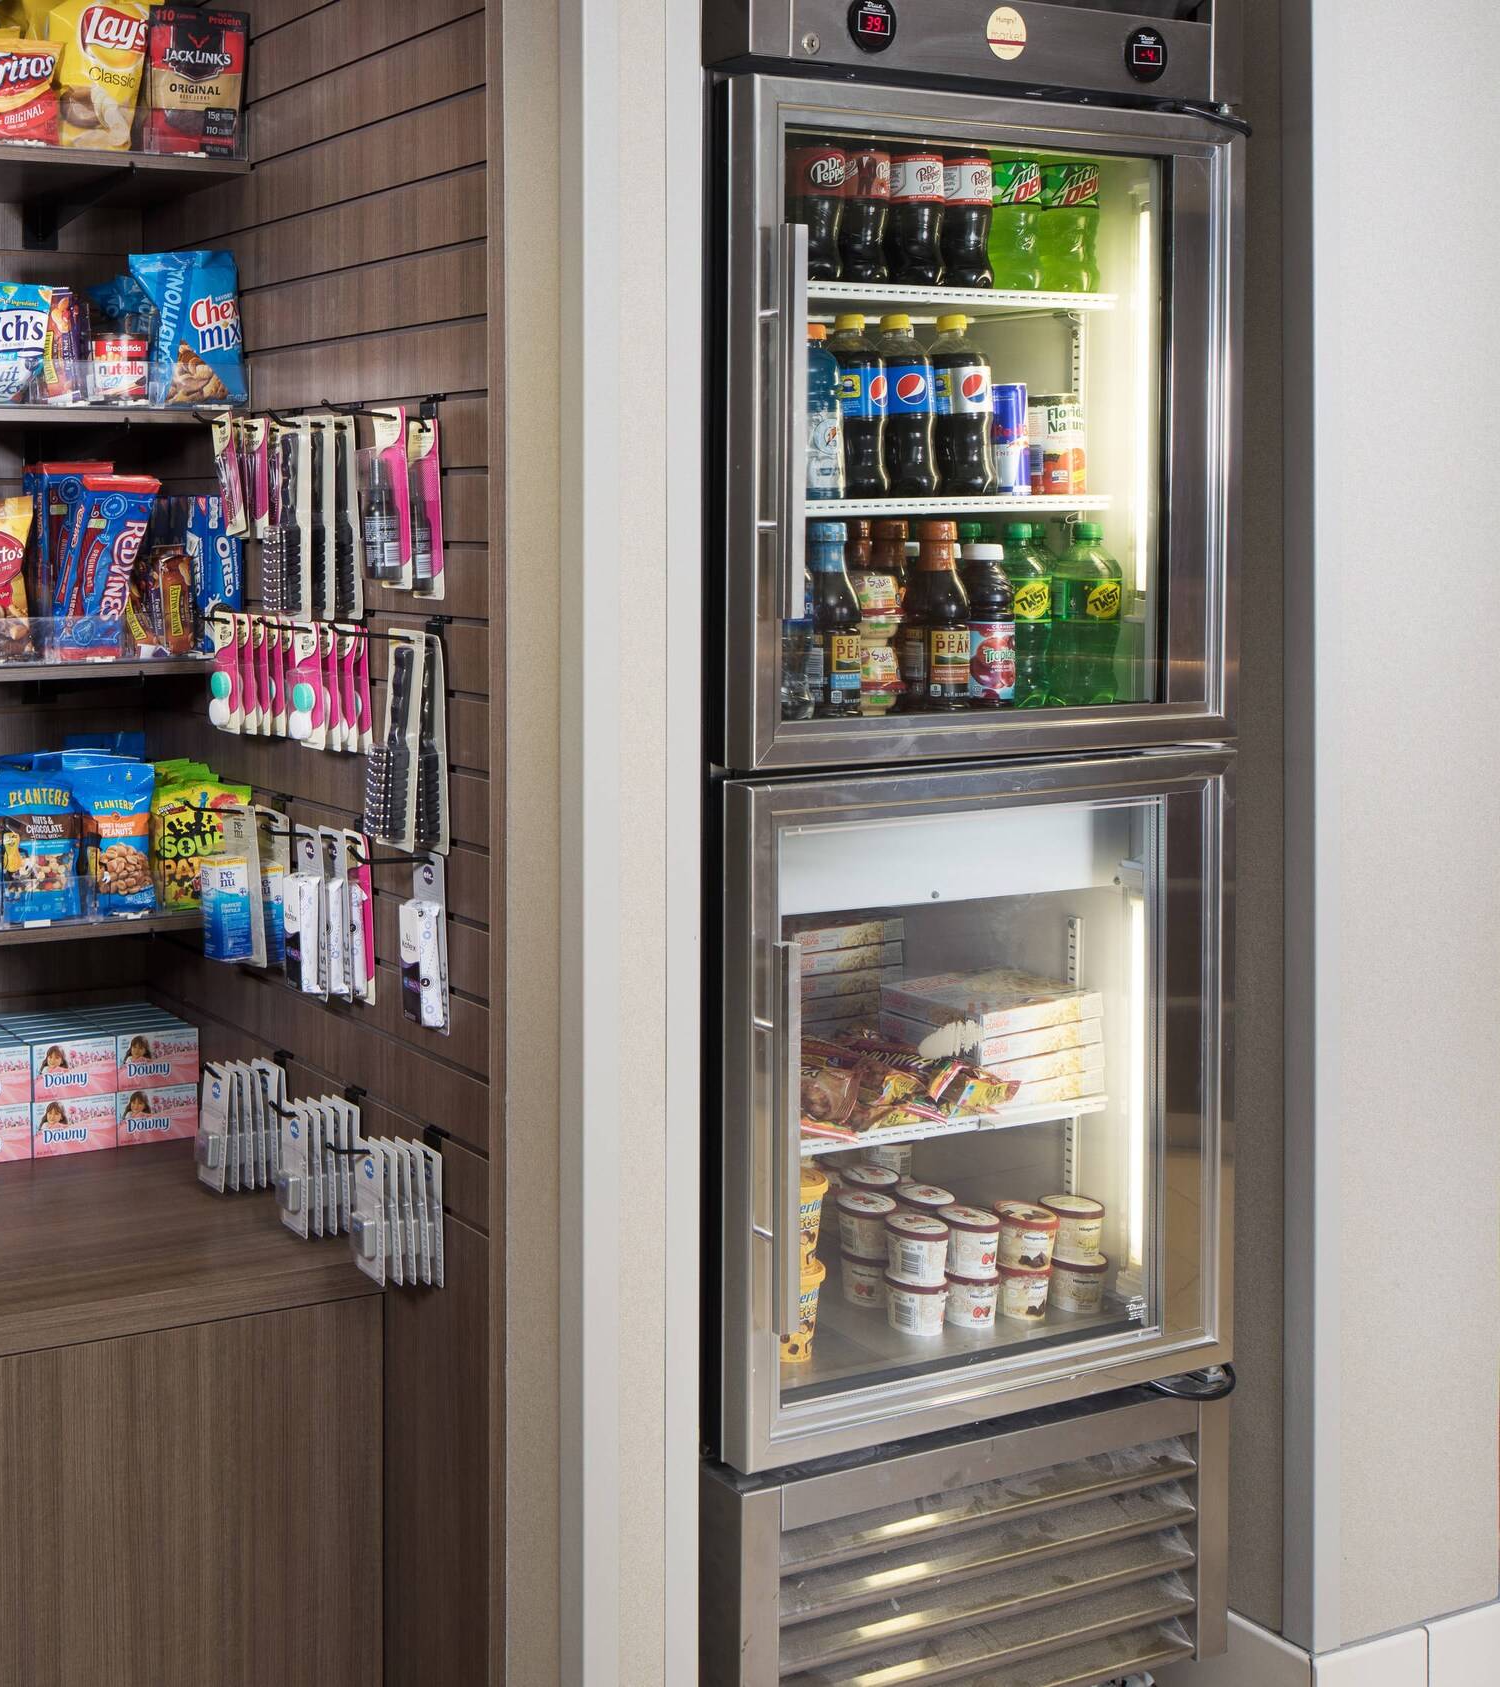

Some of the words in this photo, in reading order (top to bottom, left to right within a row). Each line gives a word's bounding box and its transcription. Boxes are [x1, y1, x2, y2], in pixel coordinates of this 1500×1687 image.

[155, 10, 175, 22] 110
[208, 16, 241, 26] Protein
[85, 8, 148, 49] Lay's
[163, 48, 193, 63] JACK
[194, 50, 232, 66] LINK'S
[88, 66, 137, 89] Classic
[4, 105, 45, 125] ORIGINAL
[816, 160, 845, 184] Peppe
[190, 297, 239, 329] Chex
[200, 322, 242, 352] mix
[105, 344, 142, 353] Breadsticks
[98, 361, 144, 377] nutella
[215, 535, 235, 598] OREO
[836, 645, 860, 659] PEA
[8, 787, 70, 808] PLANTERS
[93, 799, 134, 811] PLANTERS
[25, 823, 65, 834] CHOCOLATE
[32, 816, 47, 825] NUTS
[48, 816, 53, 825] &
[102, 827, 133, 836] PEANUTS
[160, 856, 202, 884] PAT
[219, 880, 236, 888] nu
[128, 1062, 171, 1078] Downy
[44, 1071, 88, 1089] Downy
[128, 1116, 171, 1133] Downy
[44, 1127, 87, 1144] Downy
